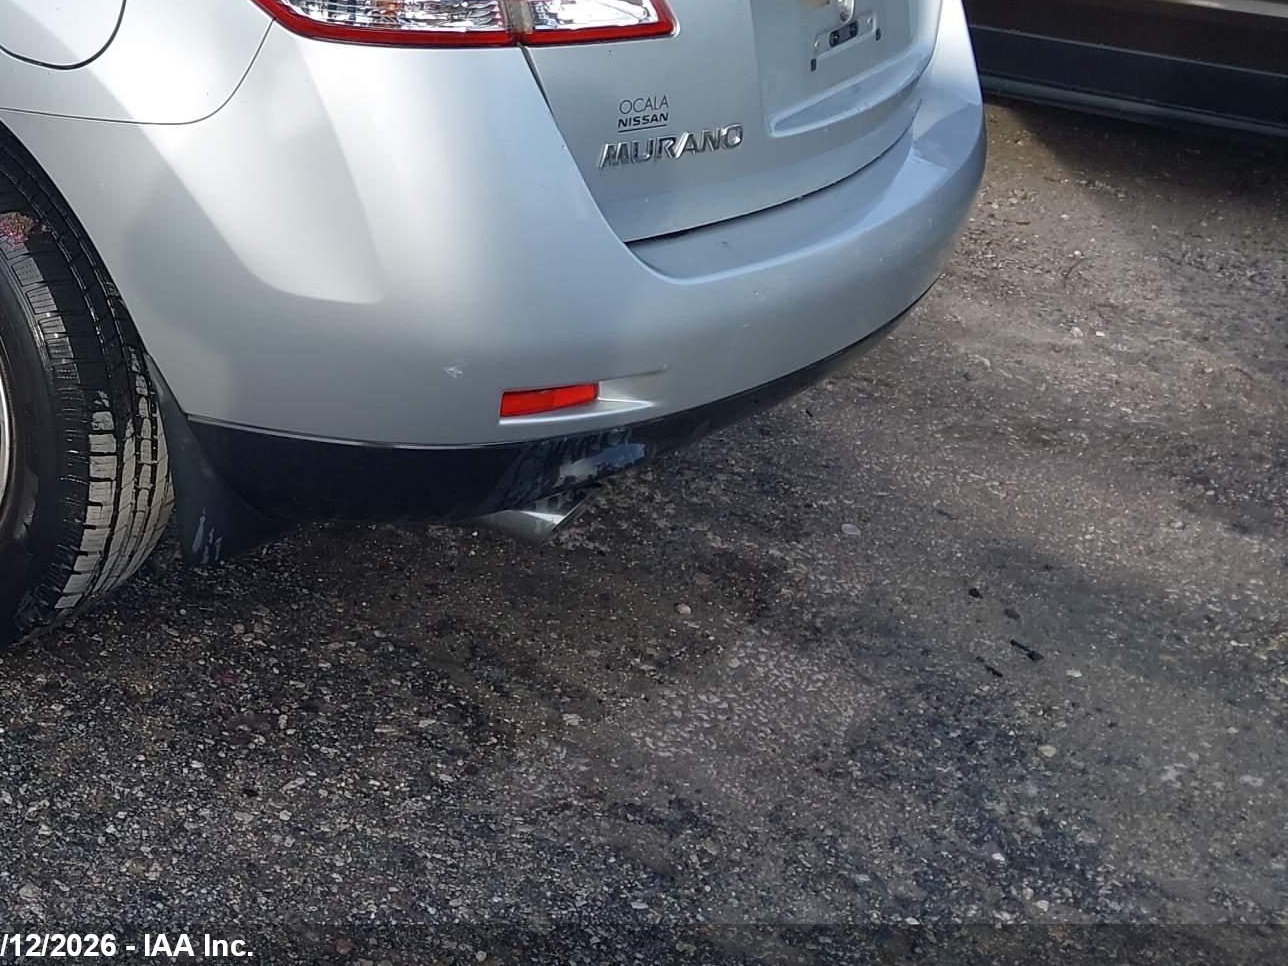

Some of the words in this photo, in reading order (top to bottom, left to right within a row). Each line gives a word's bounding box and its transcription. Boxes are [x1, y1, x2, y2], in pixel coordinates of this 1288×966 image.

[619, 95, 669, 115] OCALA
[618, 112, 669, 129] NISSAN
[598, 123, 744, 170] MURANO
